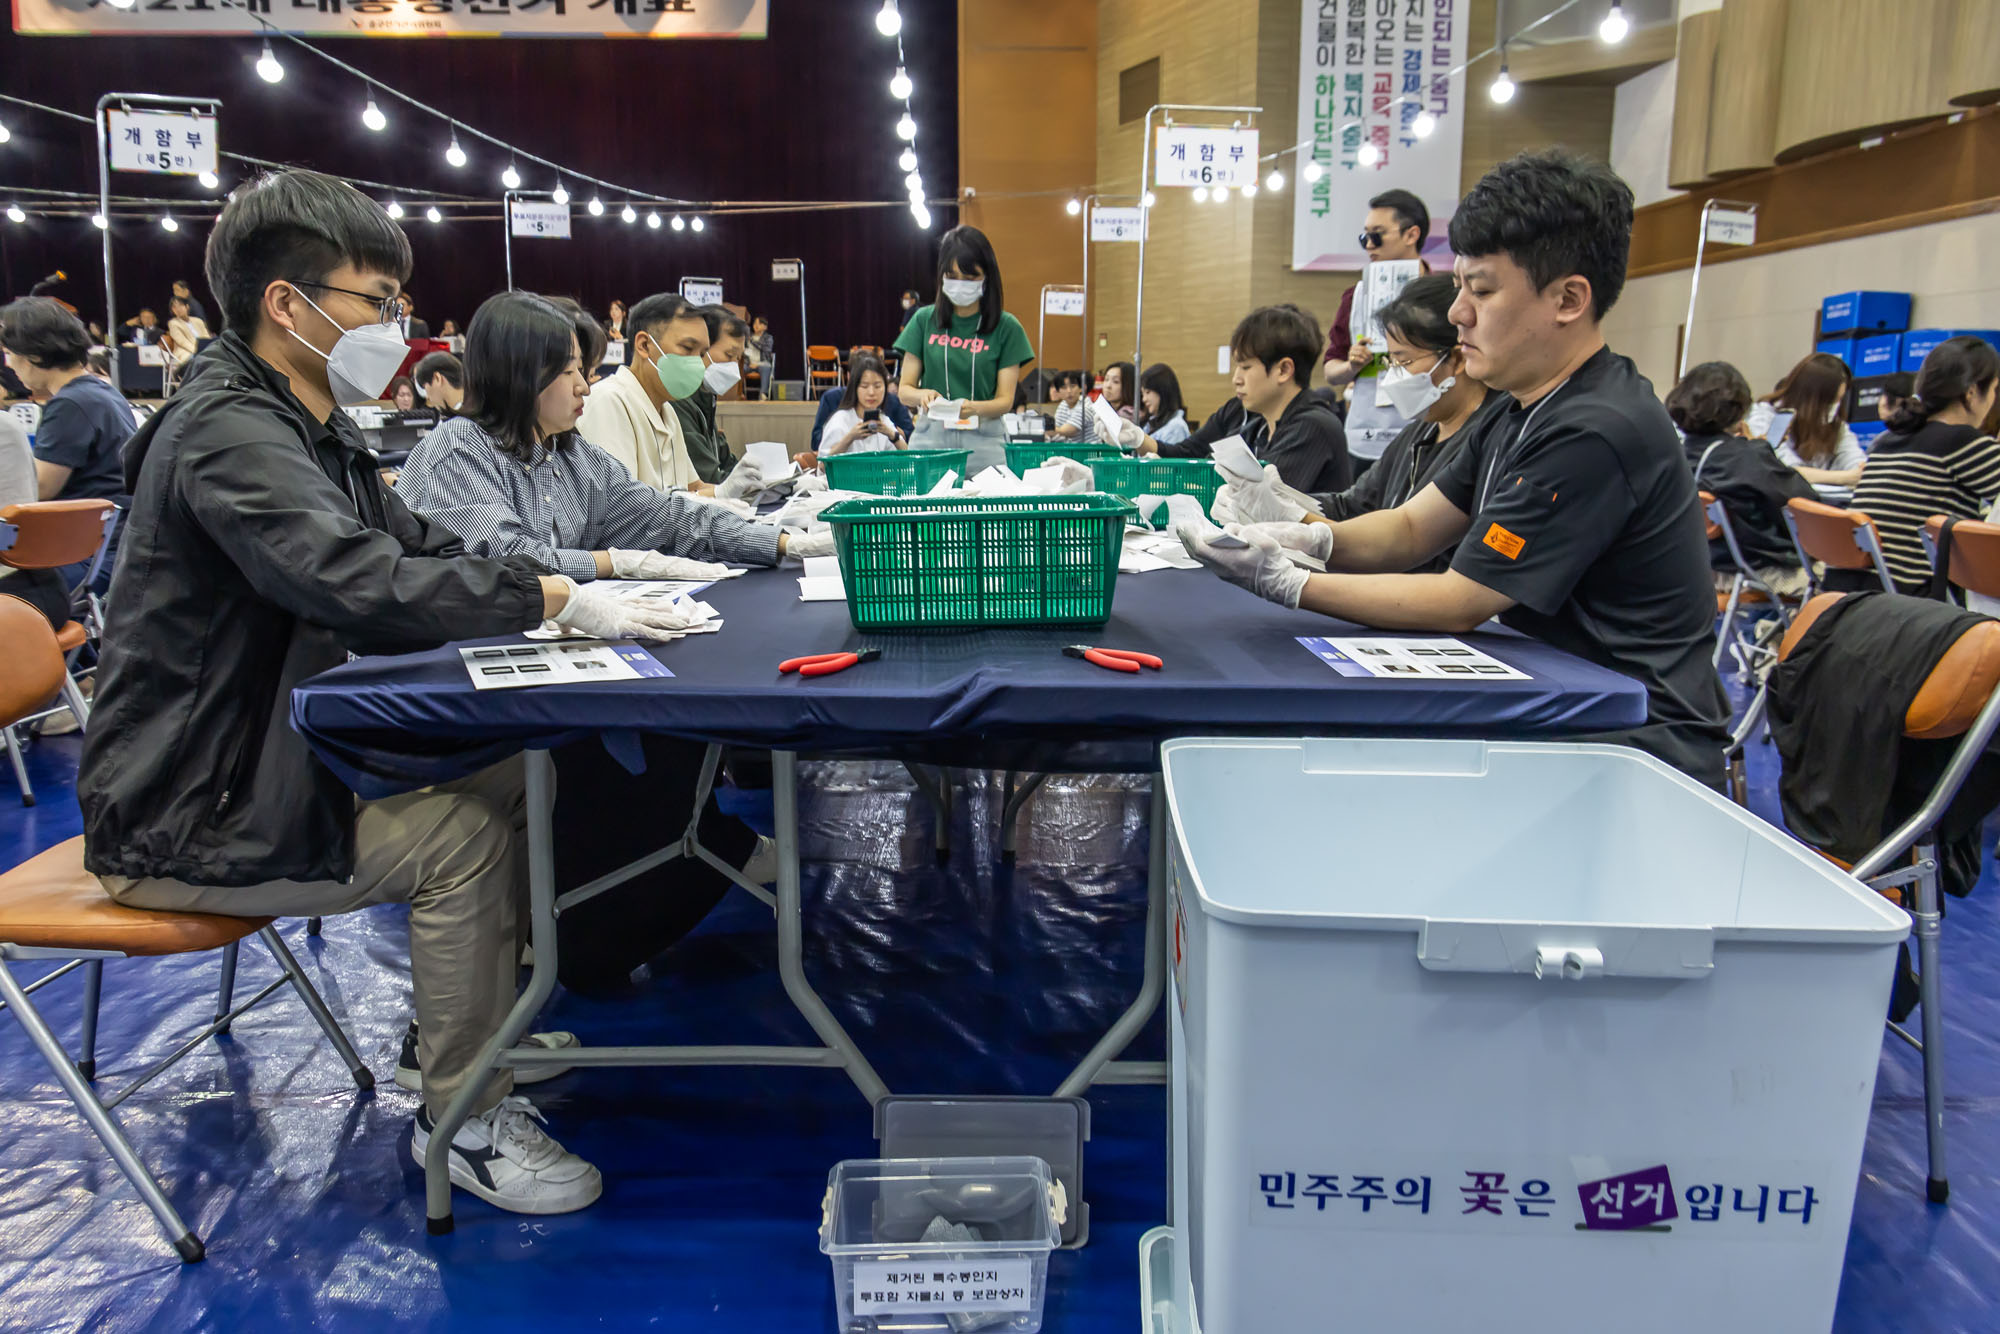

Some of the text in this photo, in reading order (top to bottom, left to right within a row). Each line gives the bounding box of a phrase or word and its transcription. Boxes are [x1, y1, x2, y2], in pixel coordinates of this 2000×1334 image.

[1401, 49, 1421, 94] 경제
[1371, 73, 1392, 118] 교육
[1430, 73, 1449, 118] 중구
[928, 333, 990, 353] reorg.
[1259, 1171, 1432, 1215] 민주주의
[1459, 1170, 1556, 1217] 꽃은
[1685, 1183, 1819, 1224] 입니다
[860, 1287, 1024, 1303] 투표함 자물쇠 등 보관상자
[886, 1270, 998, 1284] 제거된 특수봉인지
